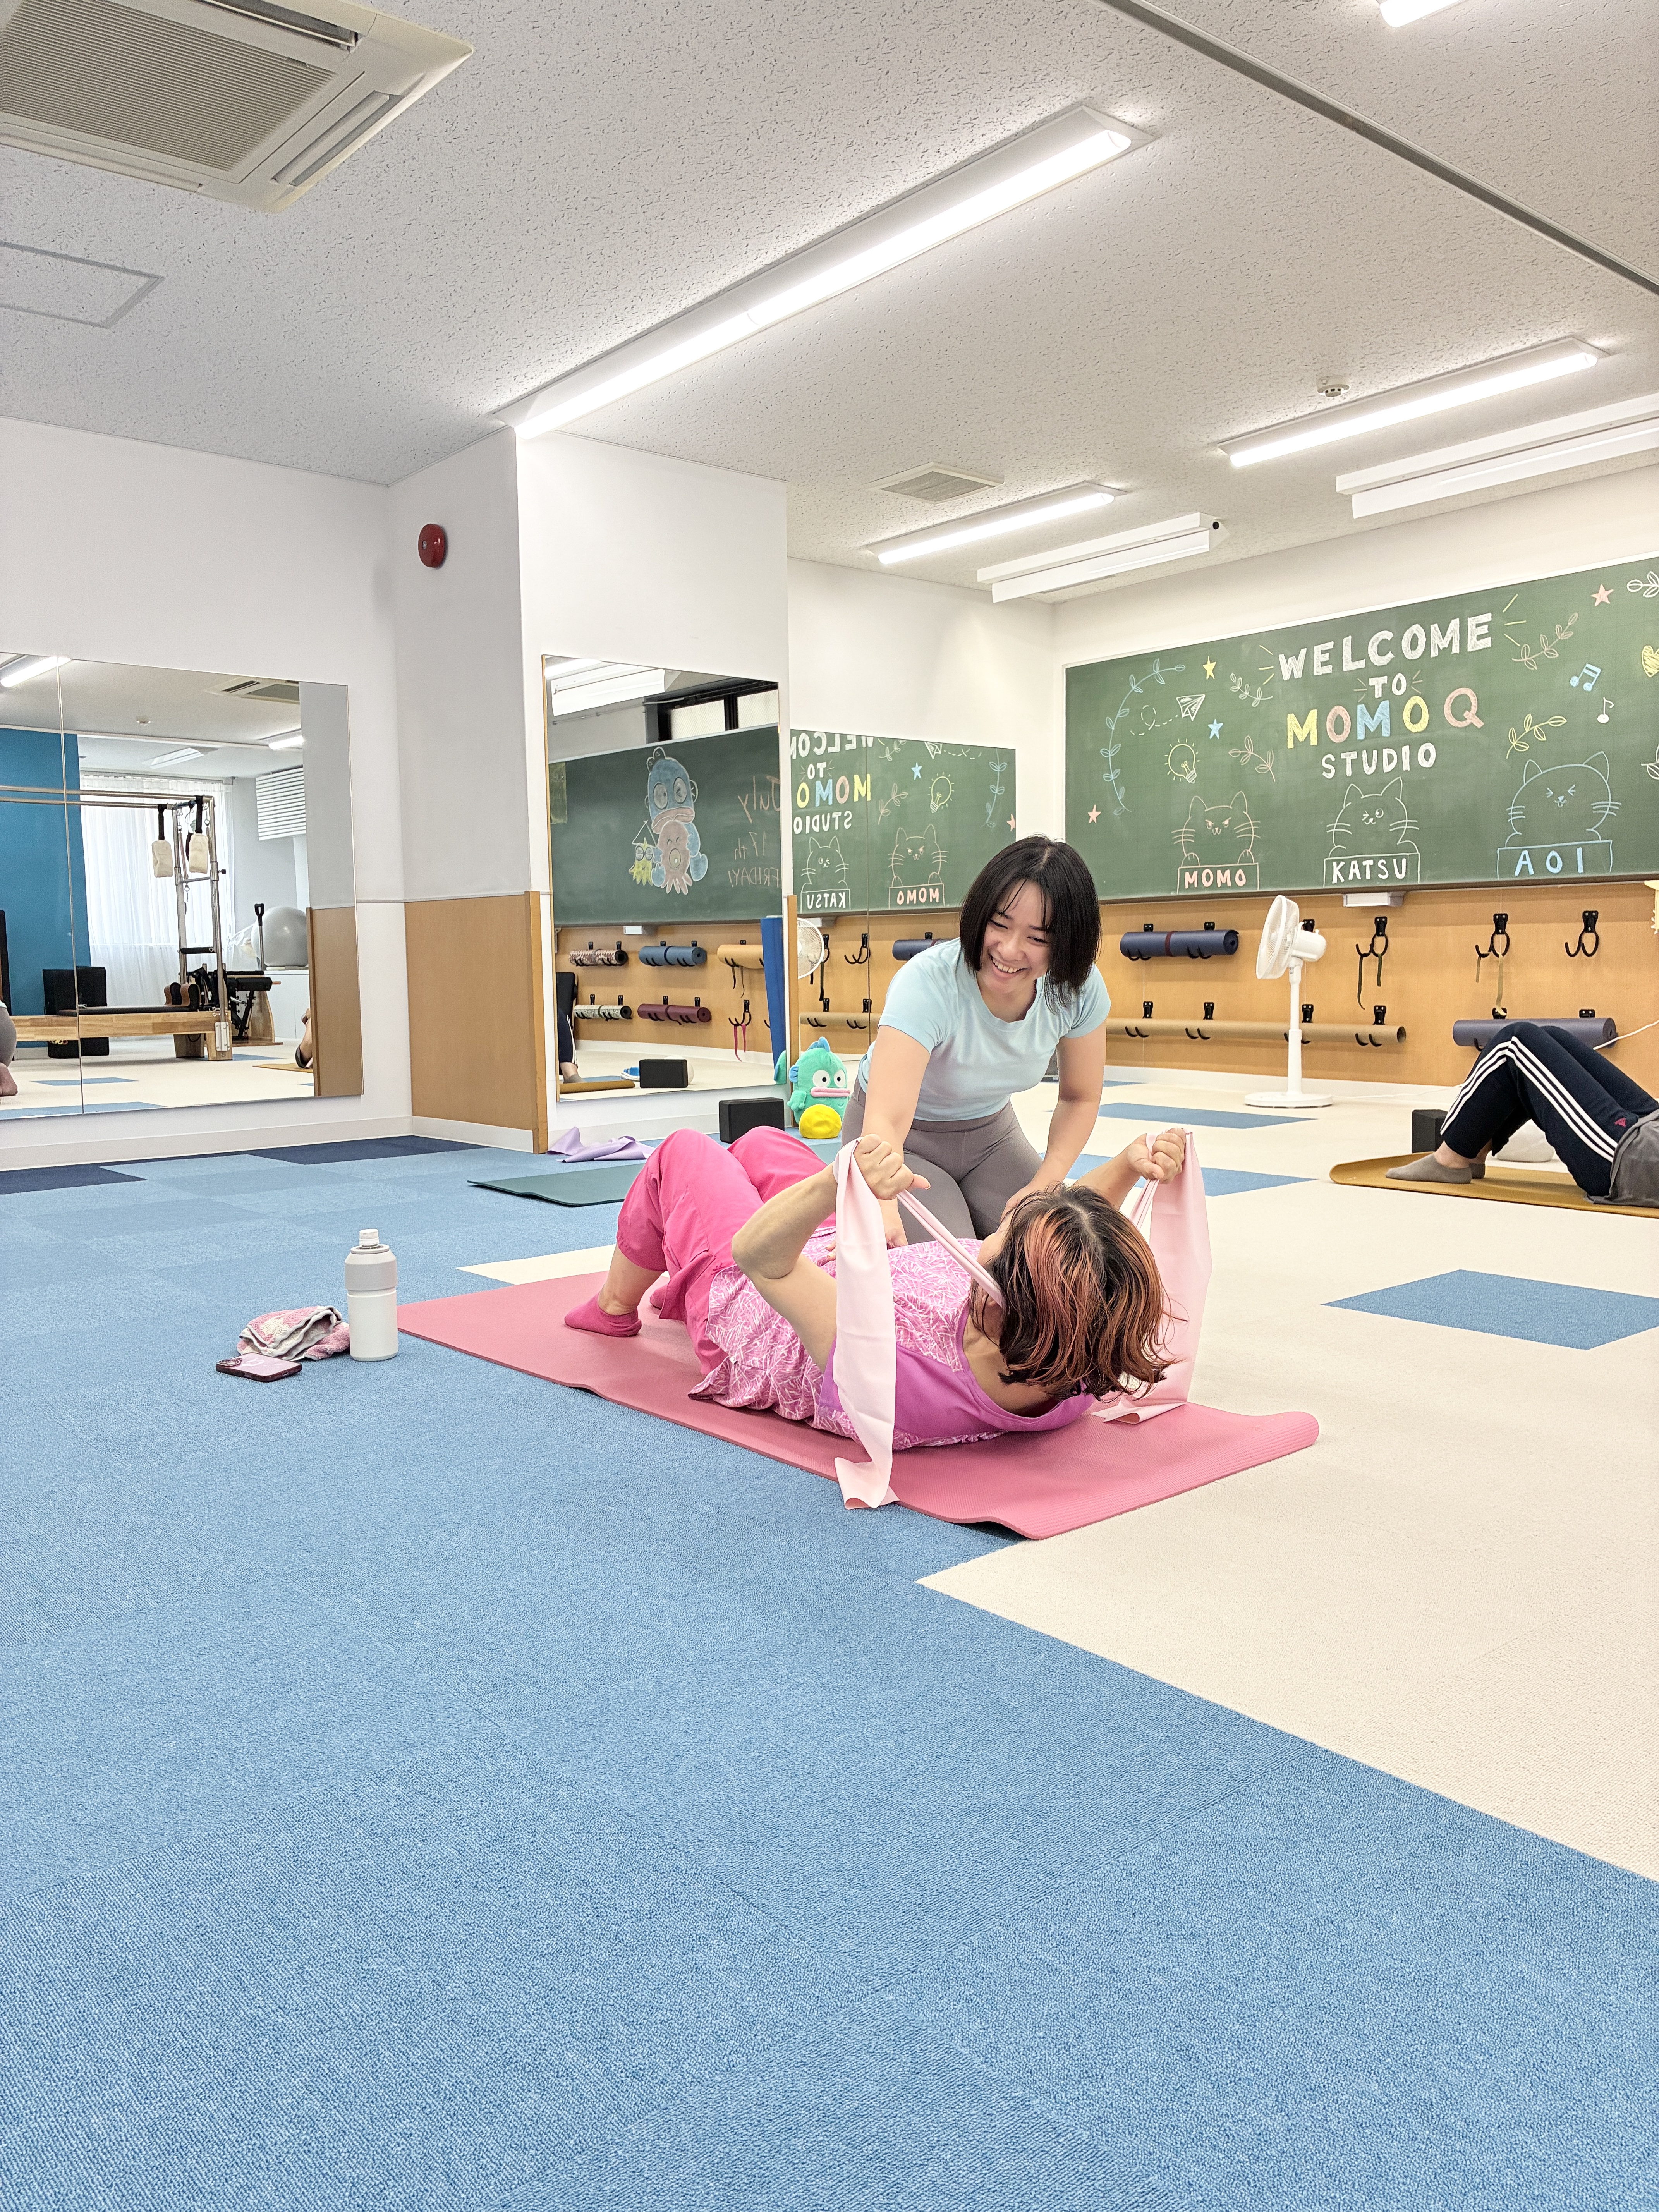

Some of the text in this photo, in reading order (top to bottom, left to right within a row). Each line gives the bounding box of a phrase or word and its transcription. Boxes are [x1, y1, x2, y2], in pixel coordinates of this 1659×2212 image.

[1279, 613, 1492, 681] WELCOME
[1369, 673, 1407, 699] TO
[1321, 742, 1436, 779] STUDIO
[1332, 857, 1407, 884] KATSU
[1515, 847, 1583, 877] AOI
[1184, 869, 1247, 889] MOMO
